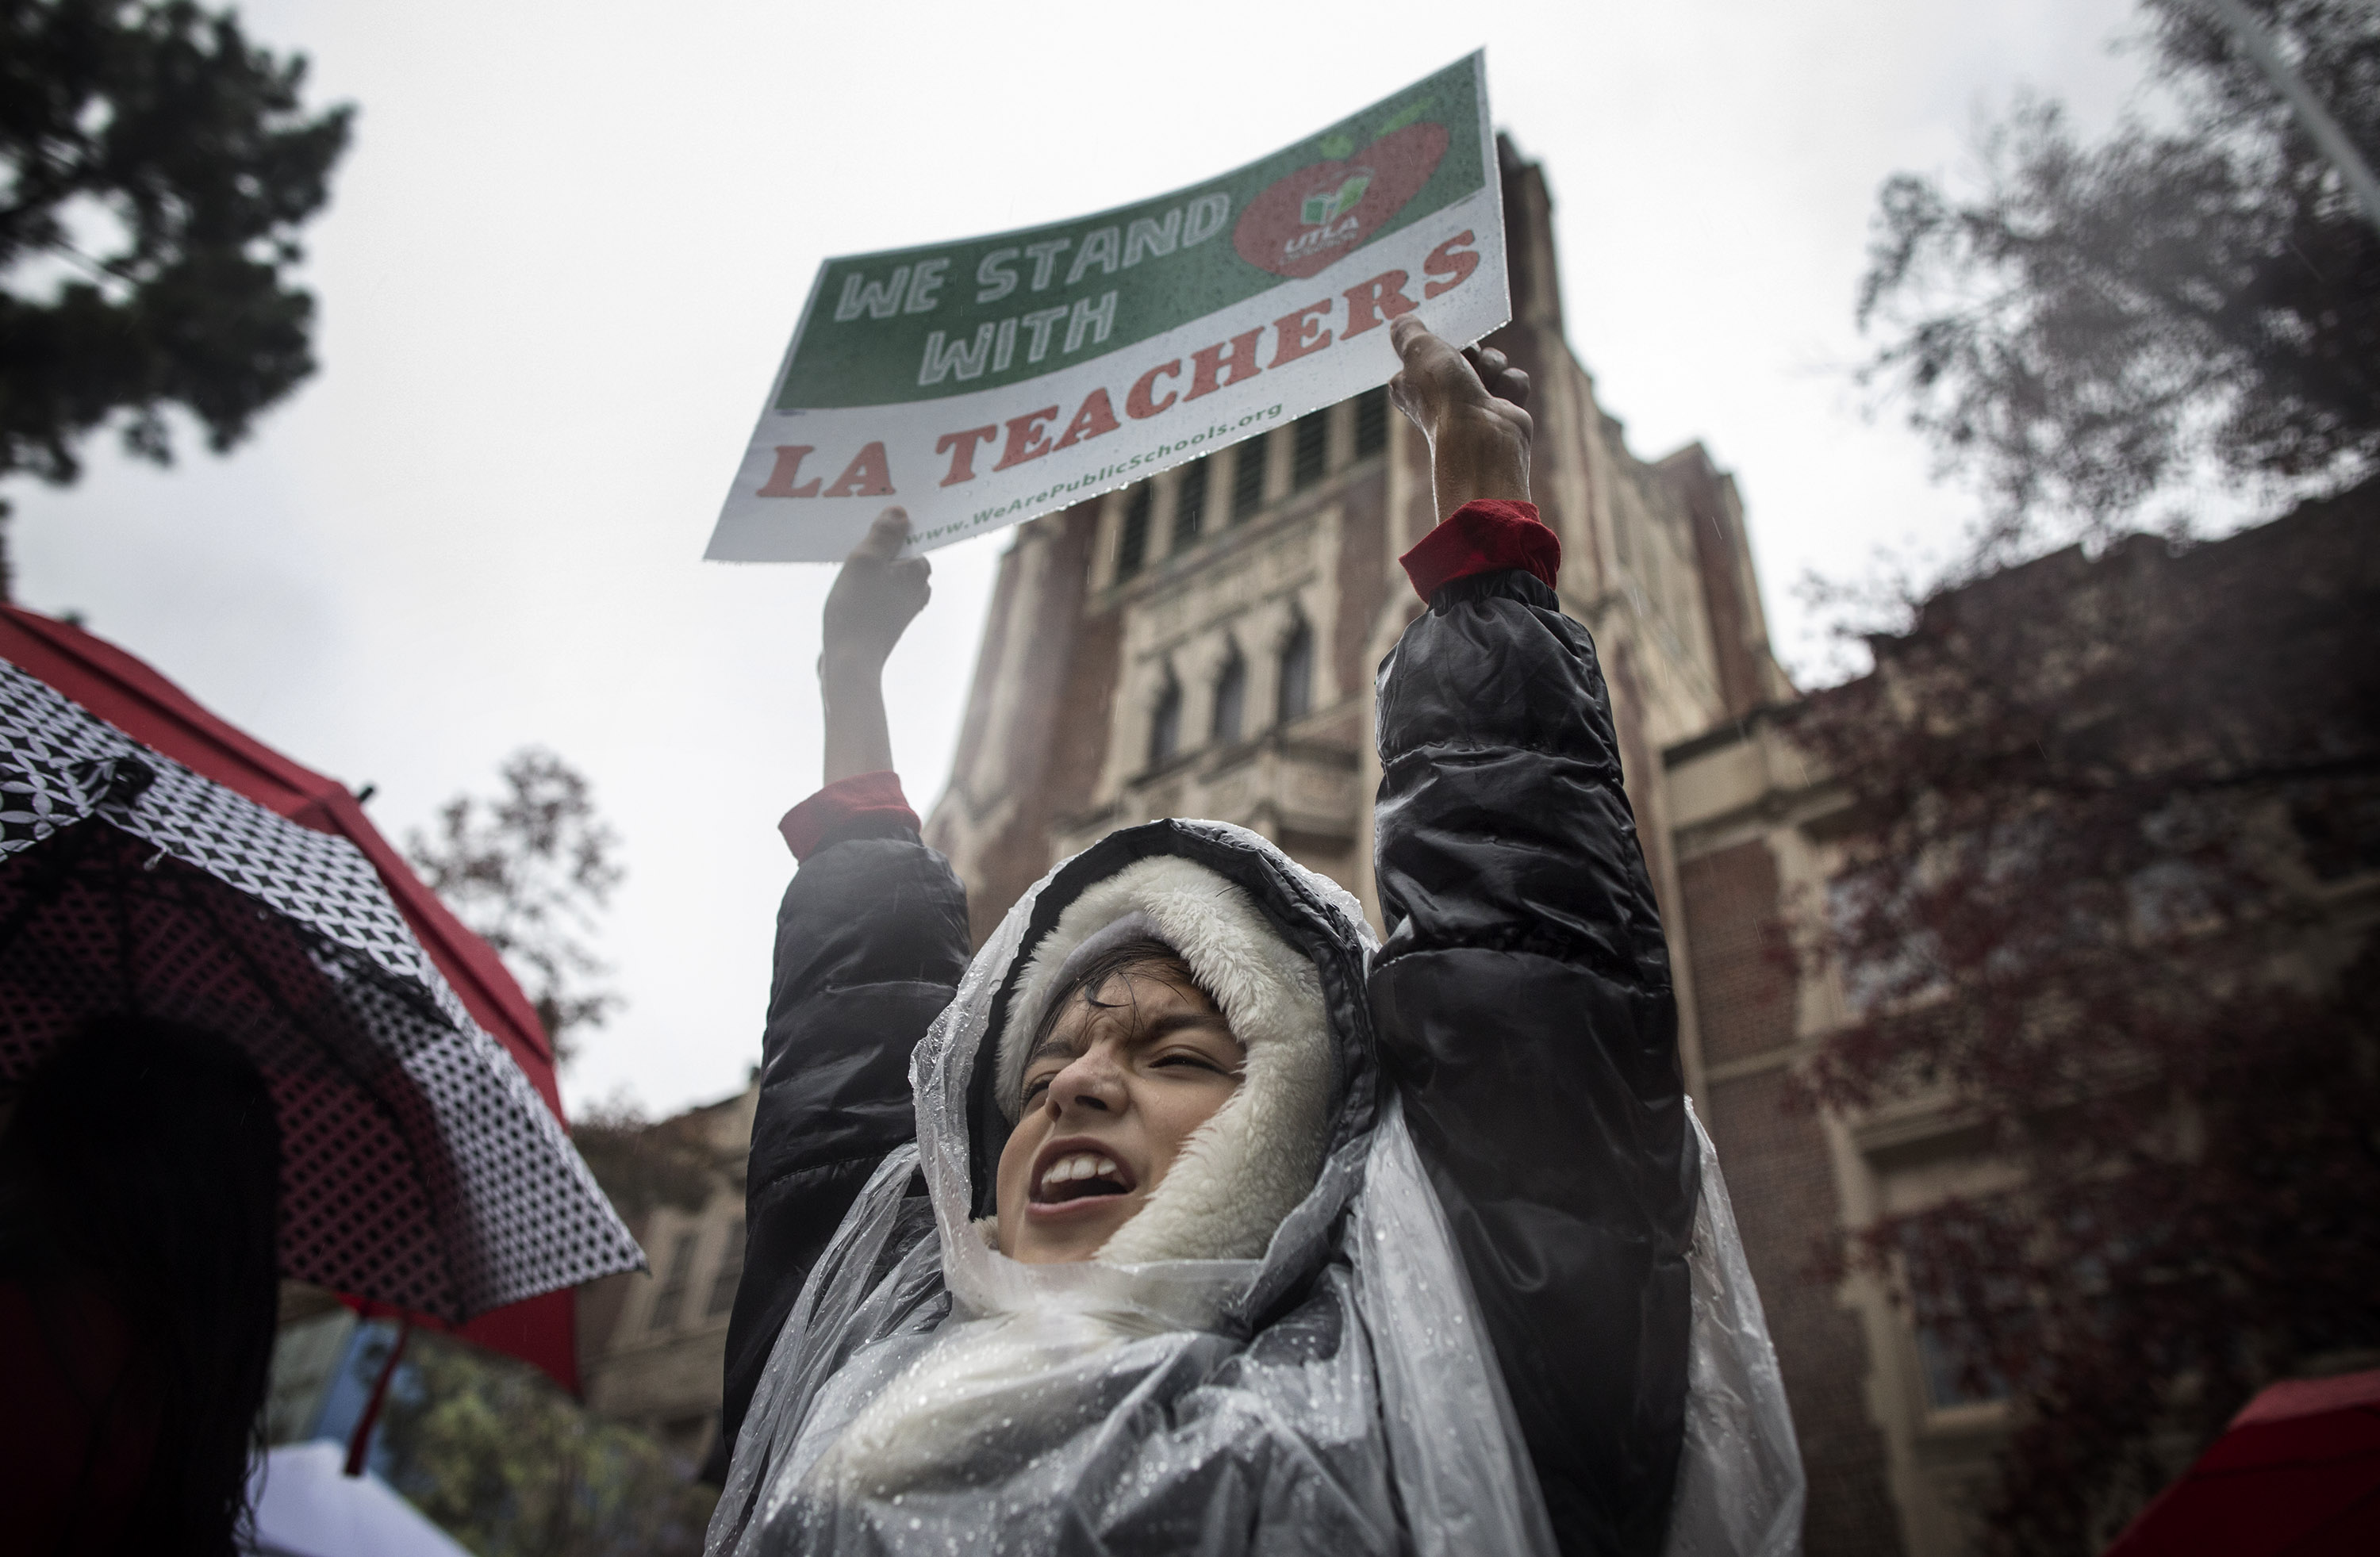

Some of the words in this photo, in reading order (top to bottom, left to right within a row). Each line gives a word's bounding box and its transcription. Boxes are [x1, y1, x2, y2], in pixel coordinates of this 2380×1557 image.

[835, 257, 950, 323] WE
[975, 191, 1231, 304] STAND
[1284, 215, 1359, 254] UTLA
[756, 441, 896, 499] LA
[935, 229, 1480, 488] TEACHERS
[917, 290, 1118, 386] WITH
